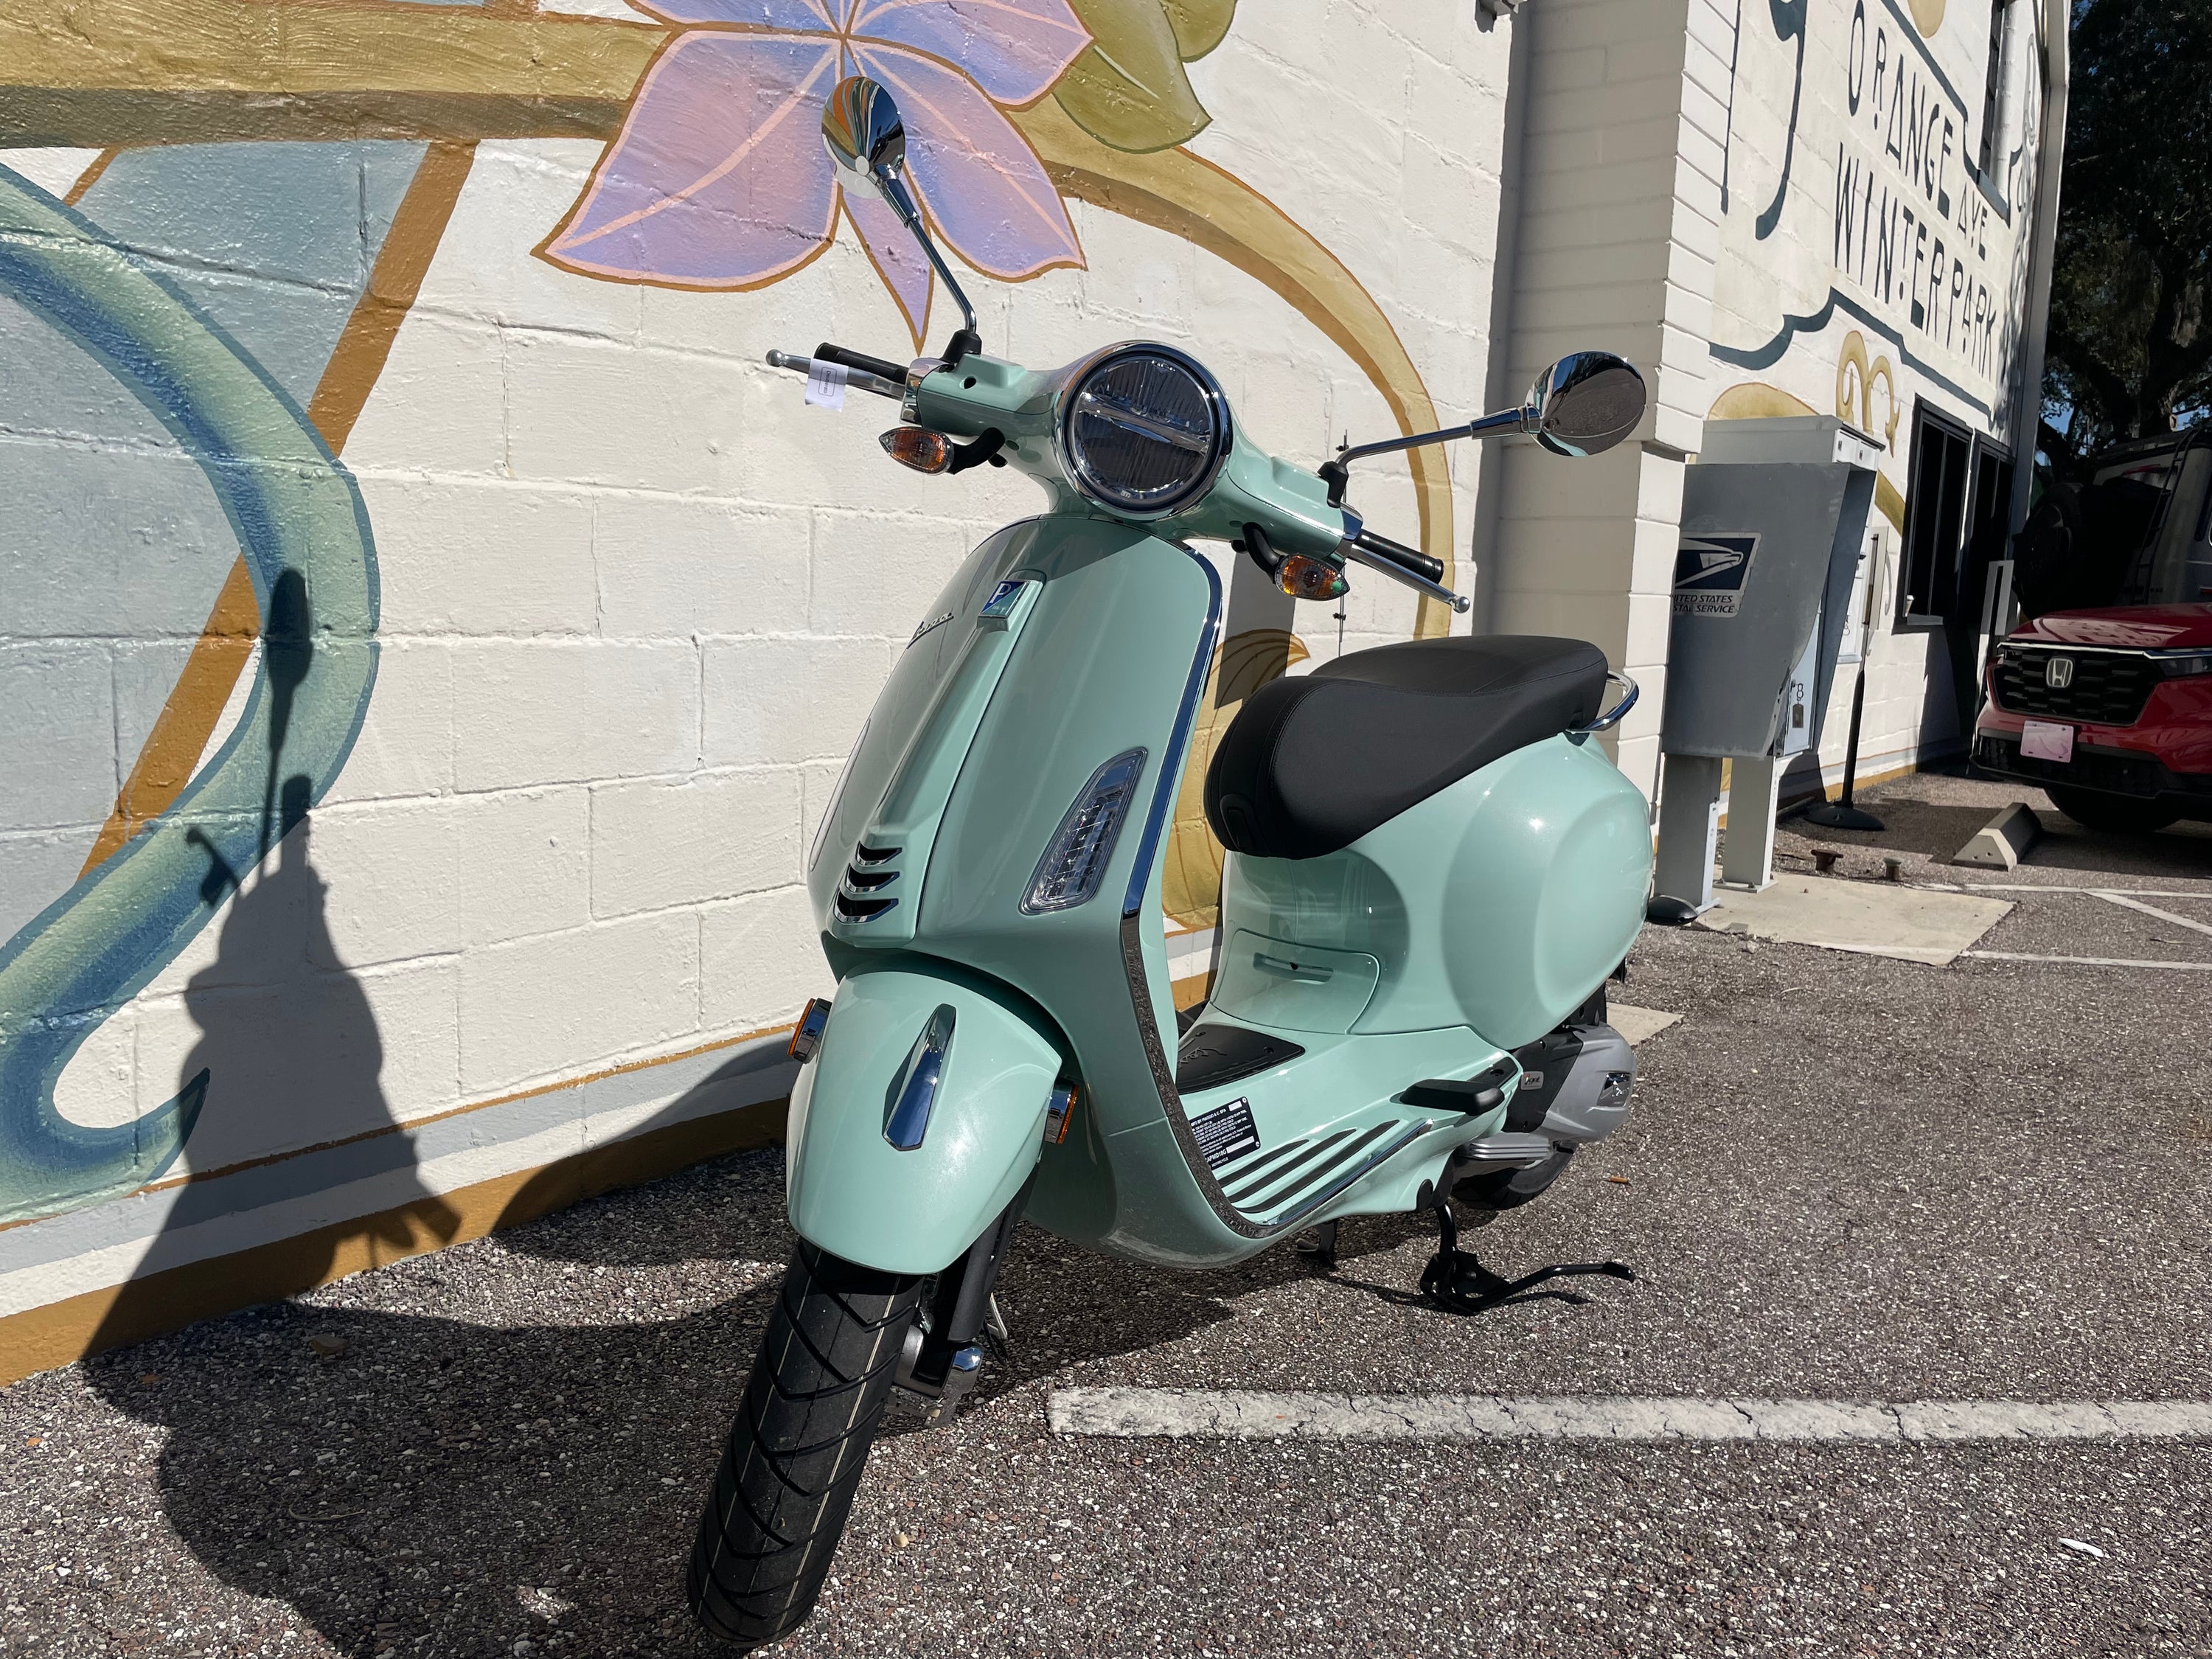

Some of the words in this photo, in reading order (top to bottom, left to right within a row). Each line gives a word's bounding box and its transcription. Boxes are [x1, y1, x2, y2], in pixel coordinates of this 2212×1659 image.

[1848, 0, 1953, 220] ORANGE
[1834, 142, 1944, 342] WINTER
[1947, 257, 1997, 383] PARK
[1673, 604, 1693, 613] STAL
[1696, 605, 1735, 613] SERVICE
[1674, 594, 1697, 603] ITED
[1699, 594, 1733, 603] STATES
